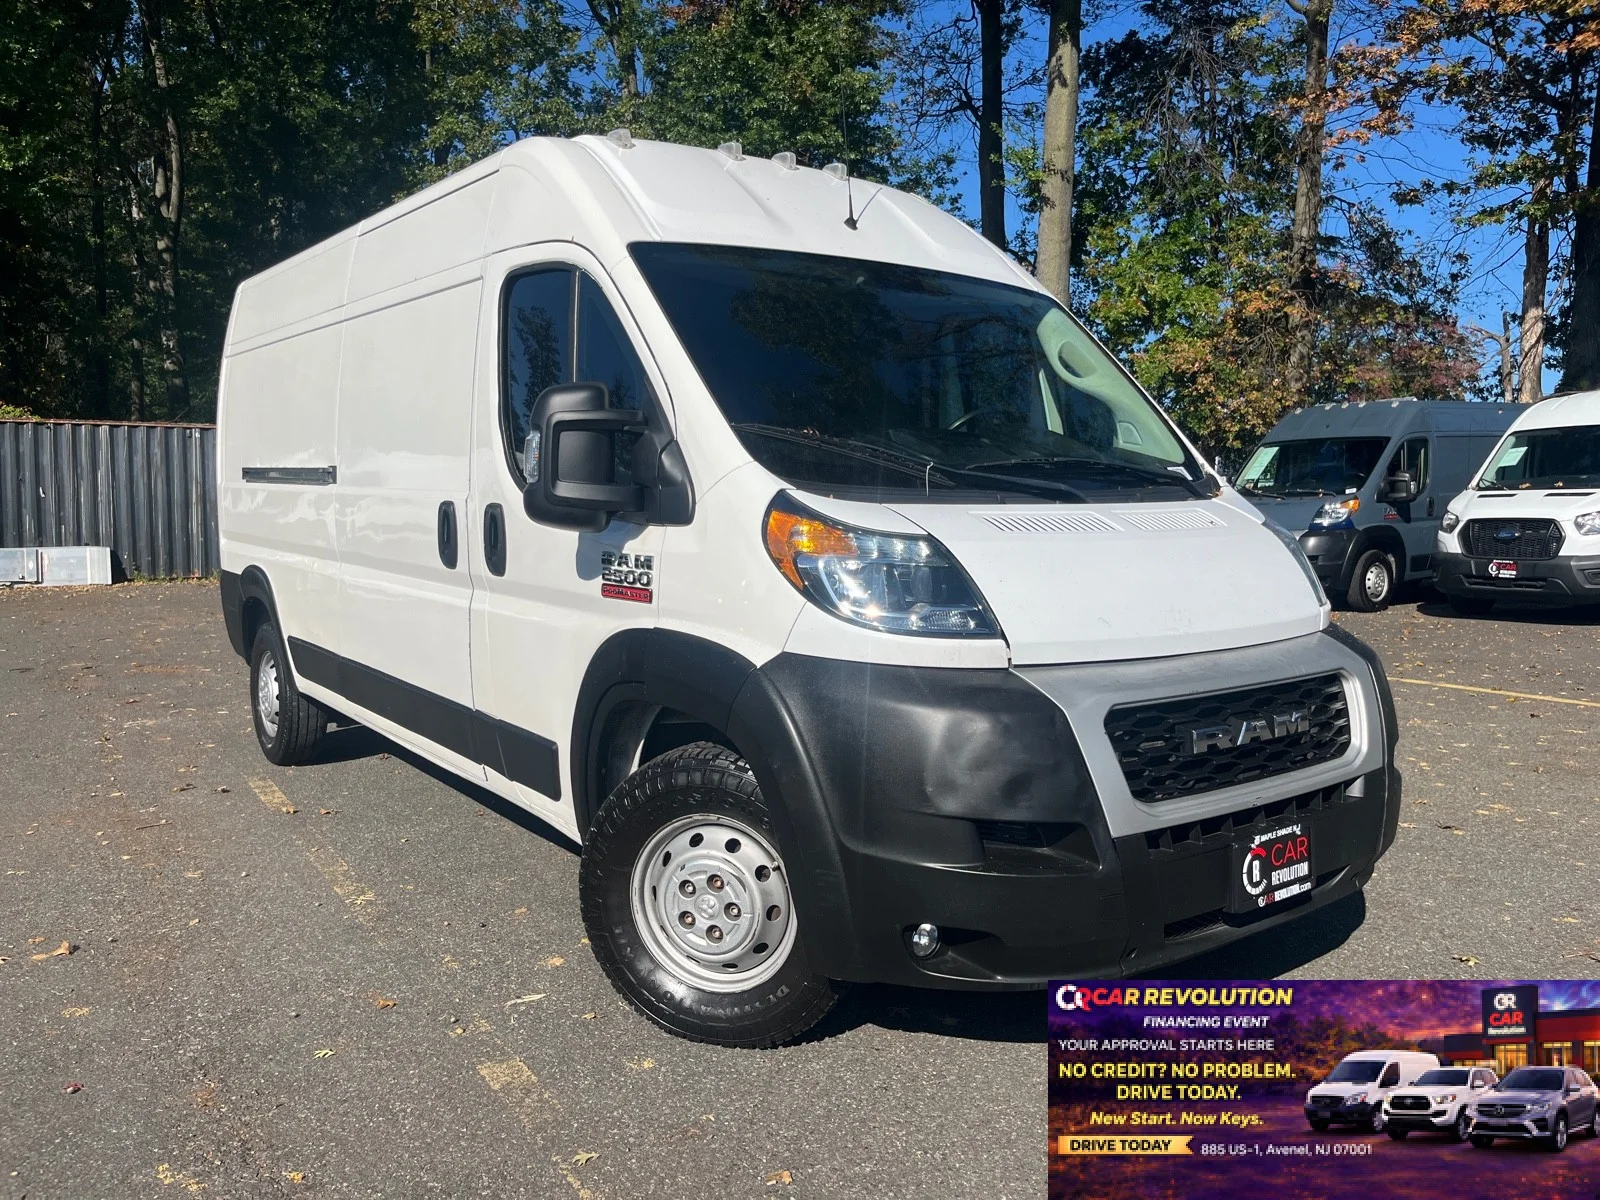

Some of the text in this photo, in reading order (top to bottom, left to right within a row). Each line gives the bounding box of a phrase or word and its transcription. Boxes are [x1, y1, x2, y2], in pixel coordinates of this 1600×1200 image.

[601, 551, 654, 571] RAM
[602, 567, 653, 587] 2500
[1192, 710, 1310, 754] RAM
[1260, 831, 1277, 842] MAPLE
[1271, 837, 1308, 866] CAR
[1271, 861, 1309, 886] REVOLUTION
